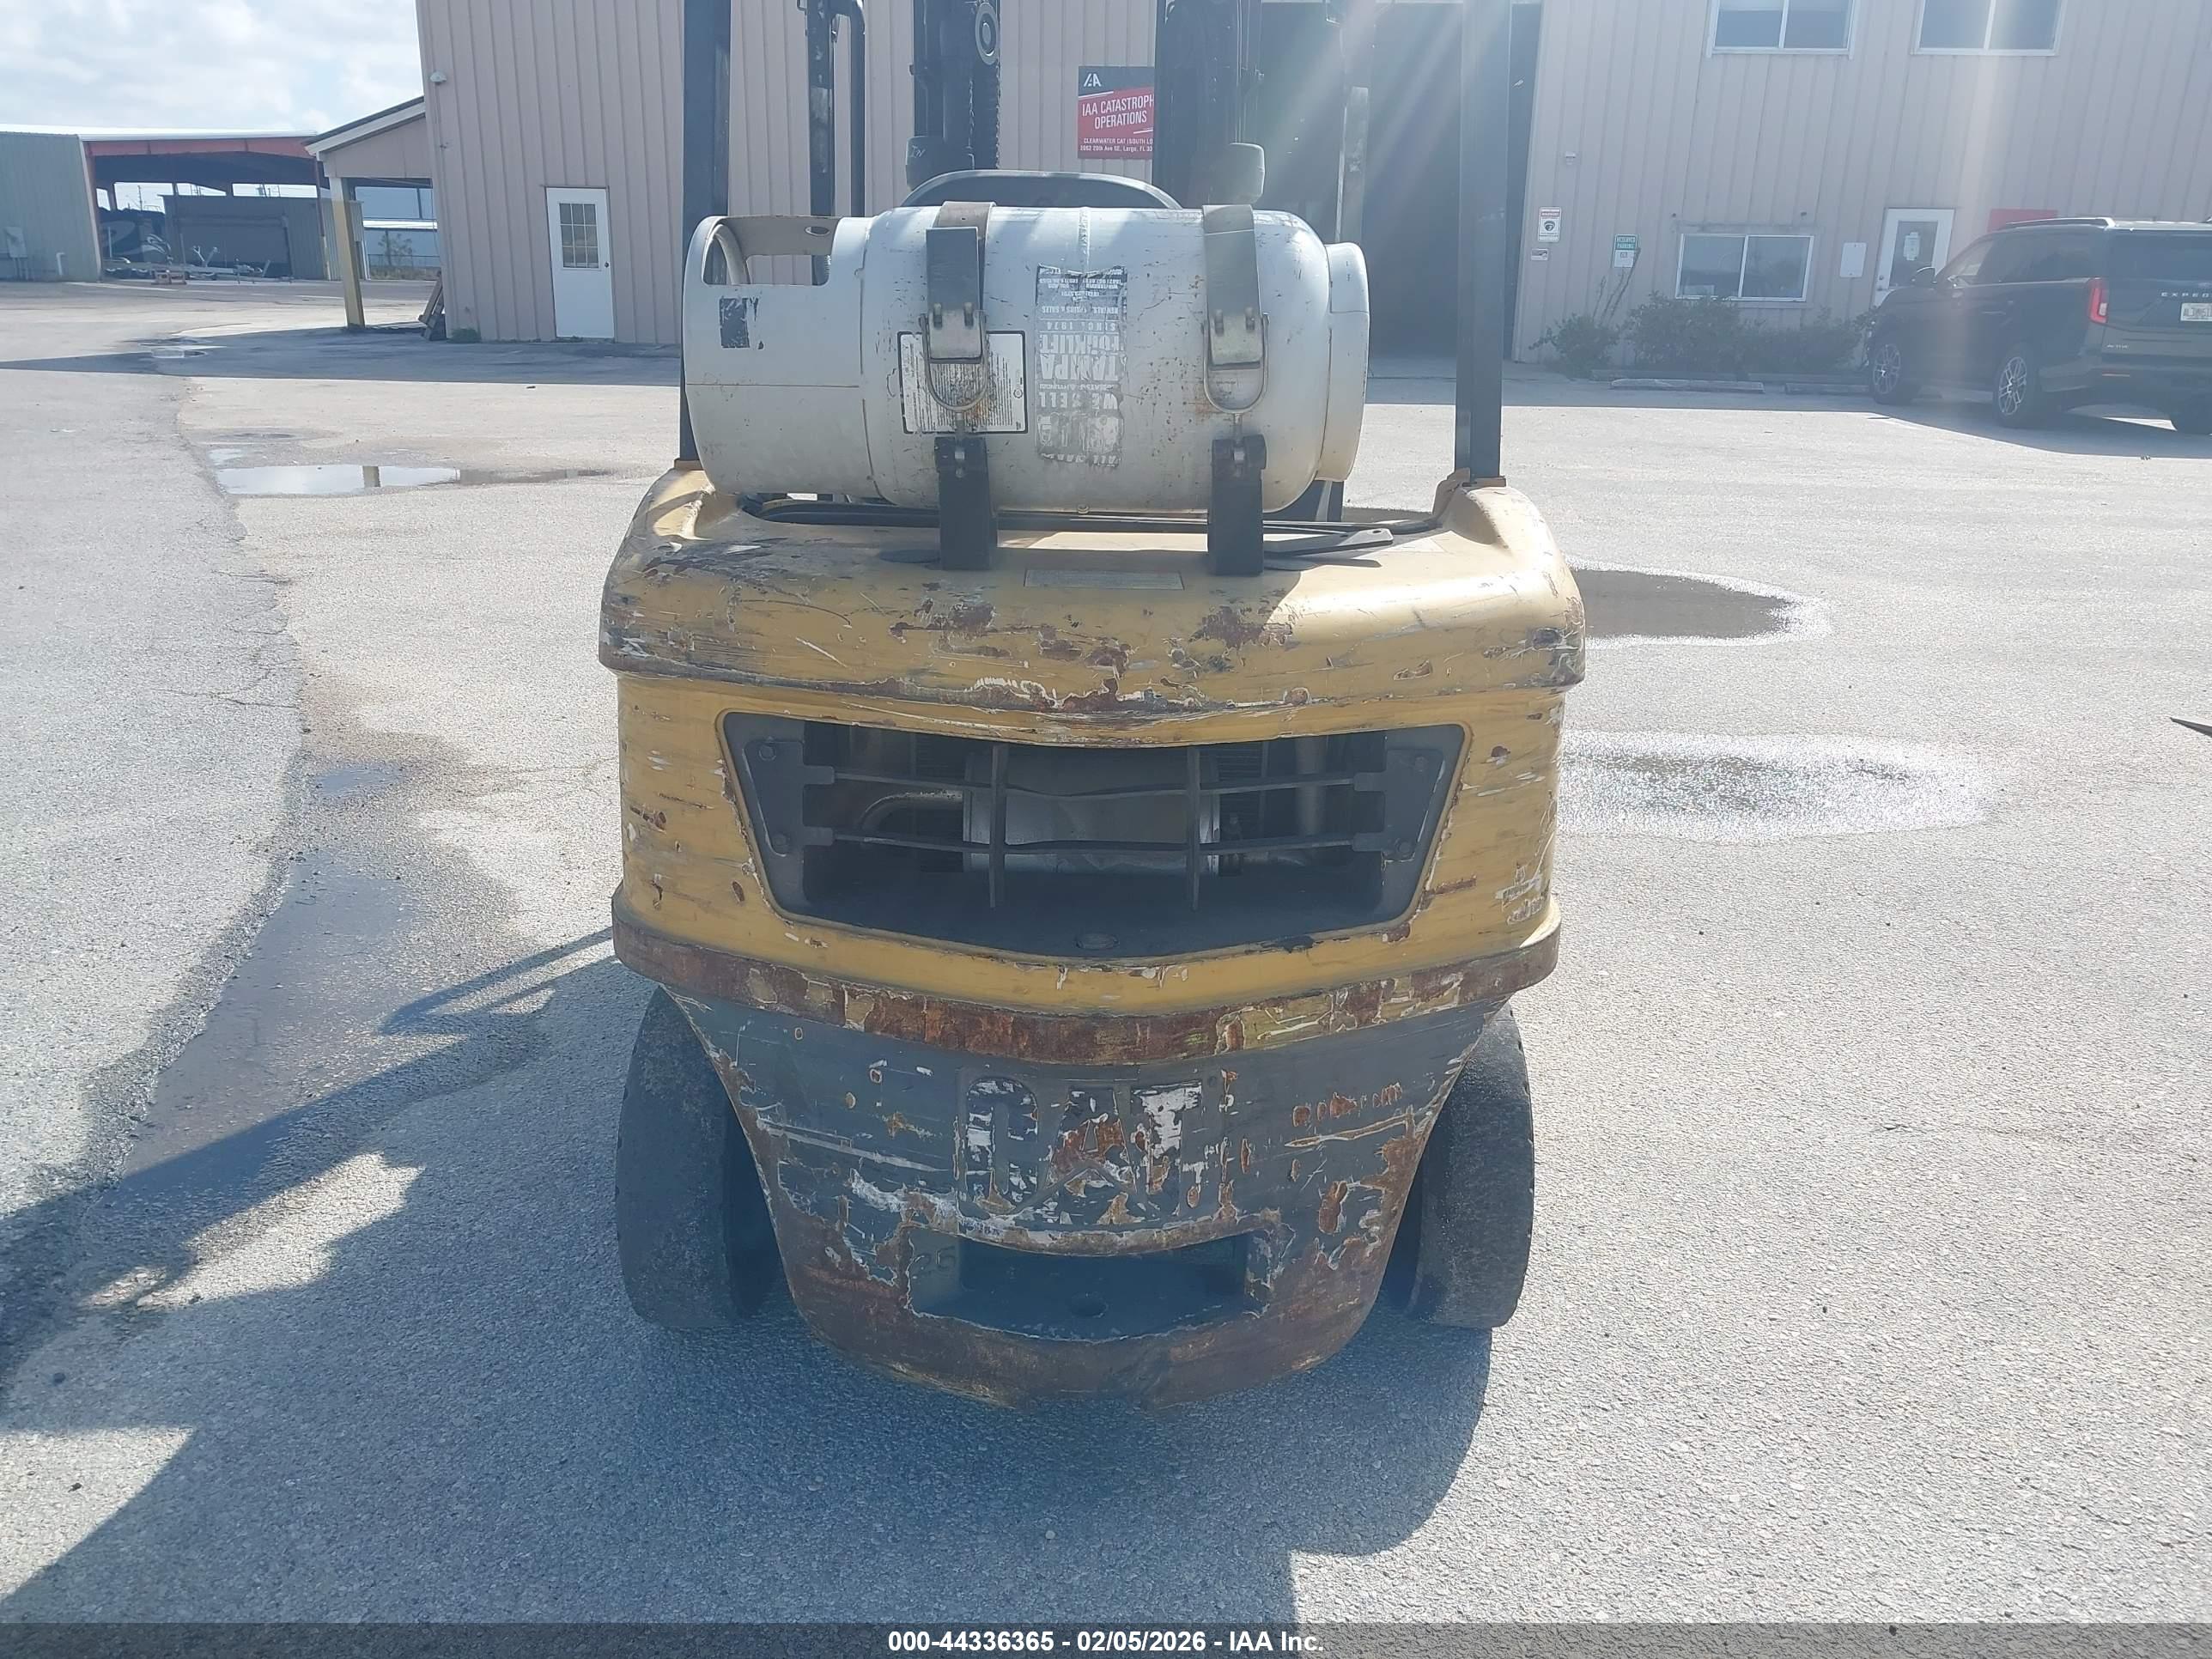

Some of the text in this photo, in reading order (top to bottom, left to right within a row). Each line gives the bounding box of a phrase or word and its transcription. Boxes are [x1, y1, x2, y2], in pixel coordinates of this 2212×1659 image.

[1082, 101, 1098, 117] IAA
[1094, 110, 1147, 130] OPERATIONS
[1047, 321, 1073, 331] 1974
[1039, 354, 1119, 381] TAMPA
[1091, 392, 1119, 410] WE
